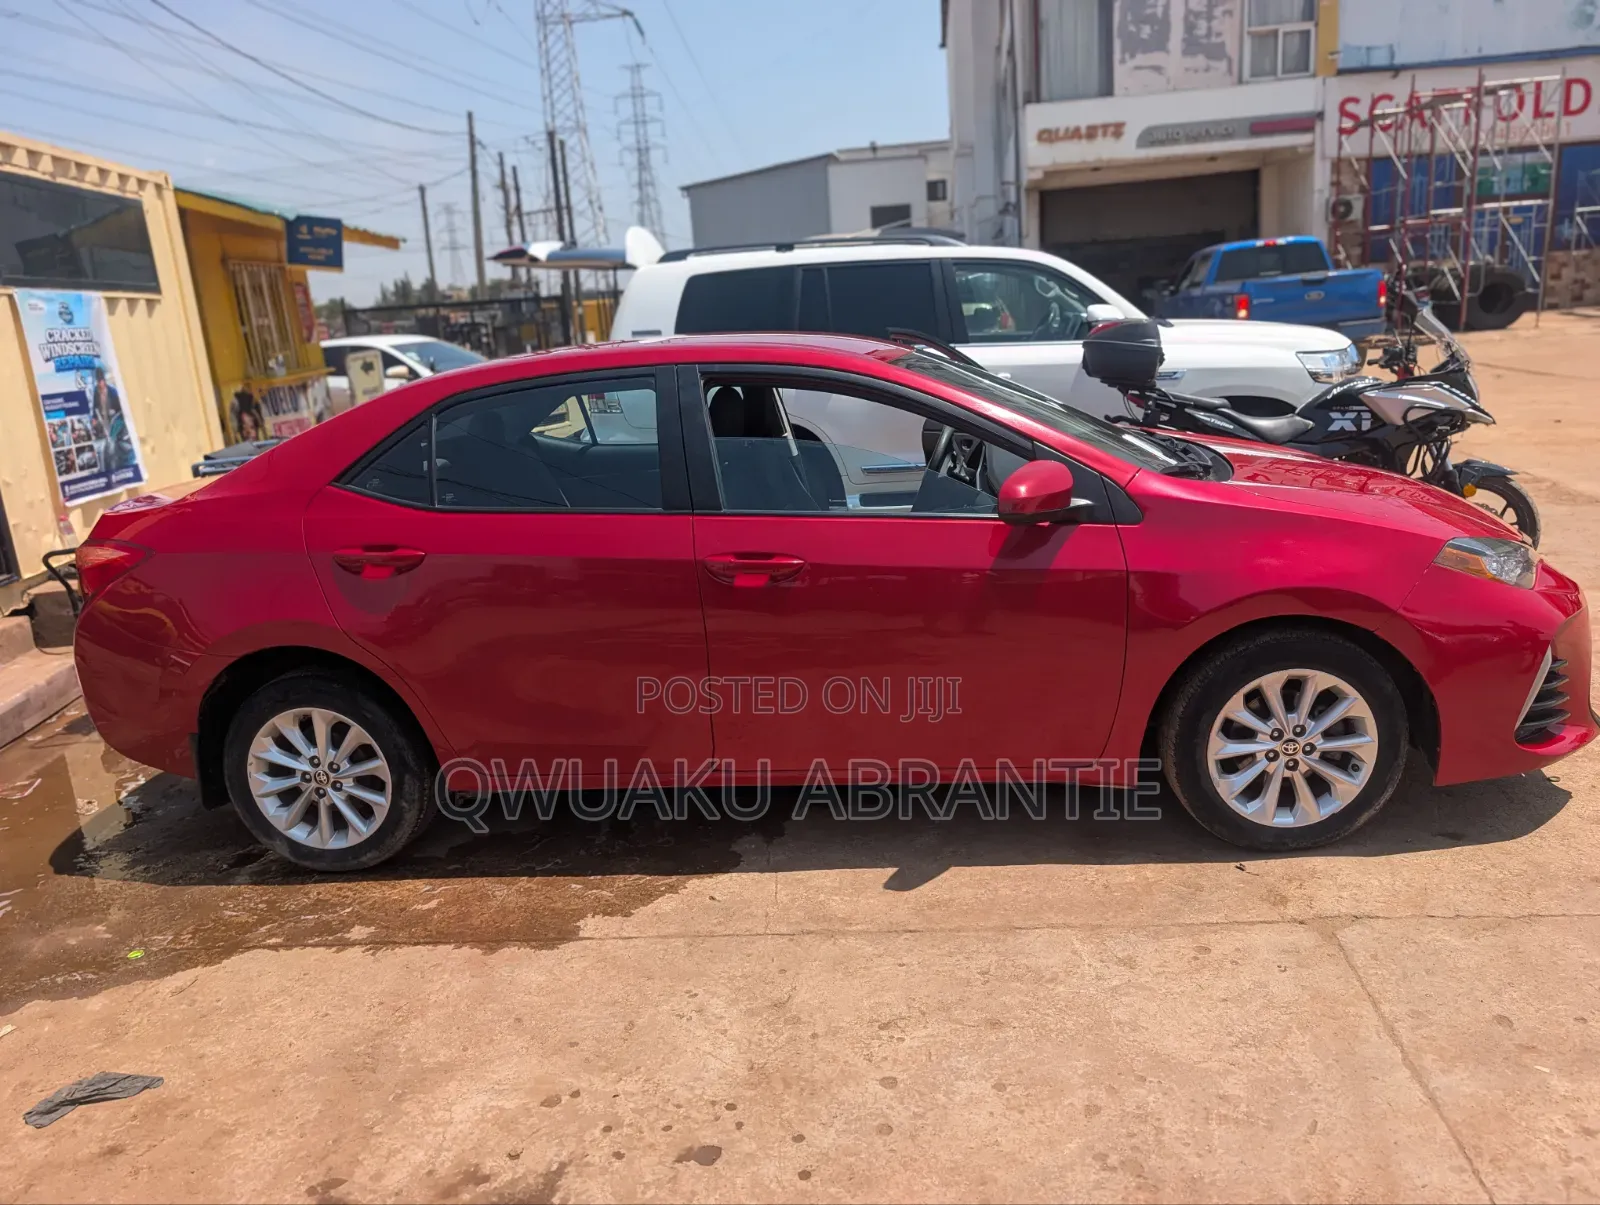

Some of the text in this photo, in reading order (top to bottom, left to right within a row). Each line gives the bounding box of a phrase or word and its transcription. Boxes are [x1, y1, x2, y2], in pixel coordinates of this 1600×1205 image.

[1338, 77, 1593, 135] SCAFOLD
[45, 328, 93, 342] CRACKED
[39, 341, 101, 362] WINDSCREEN
